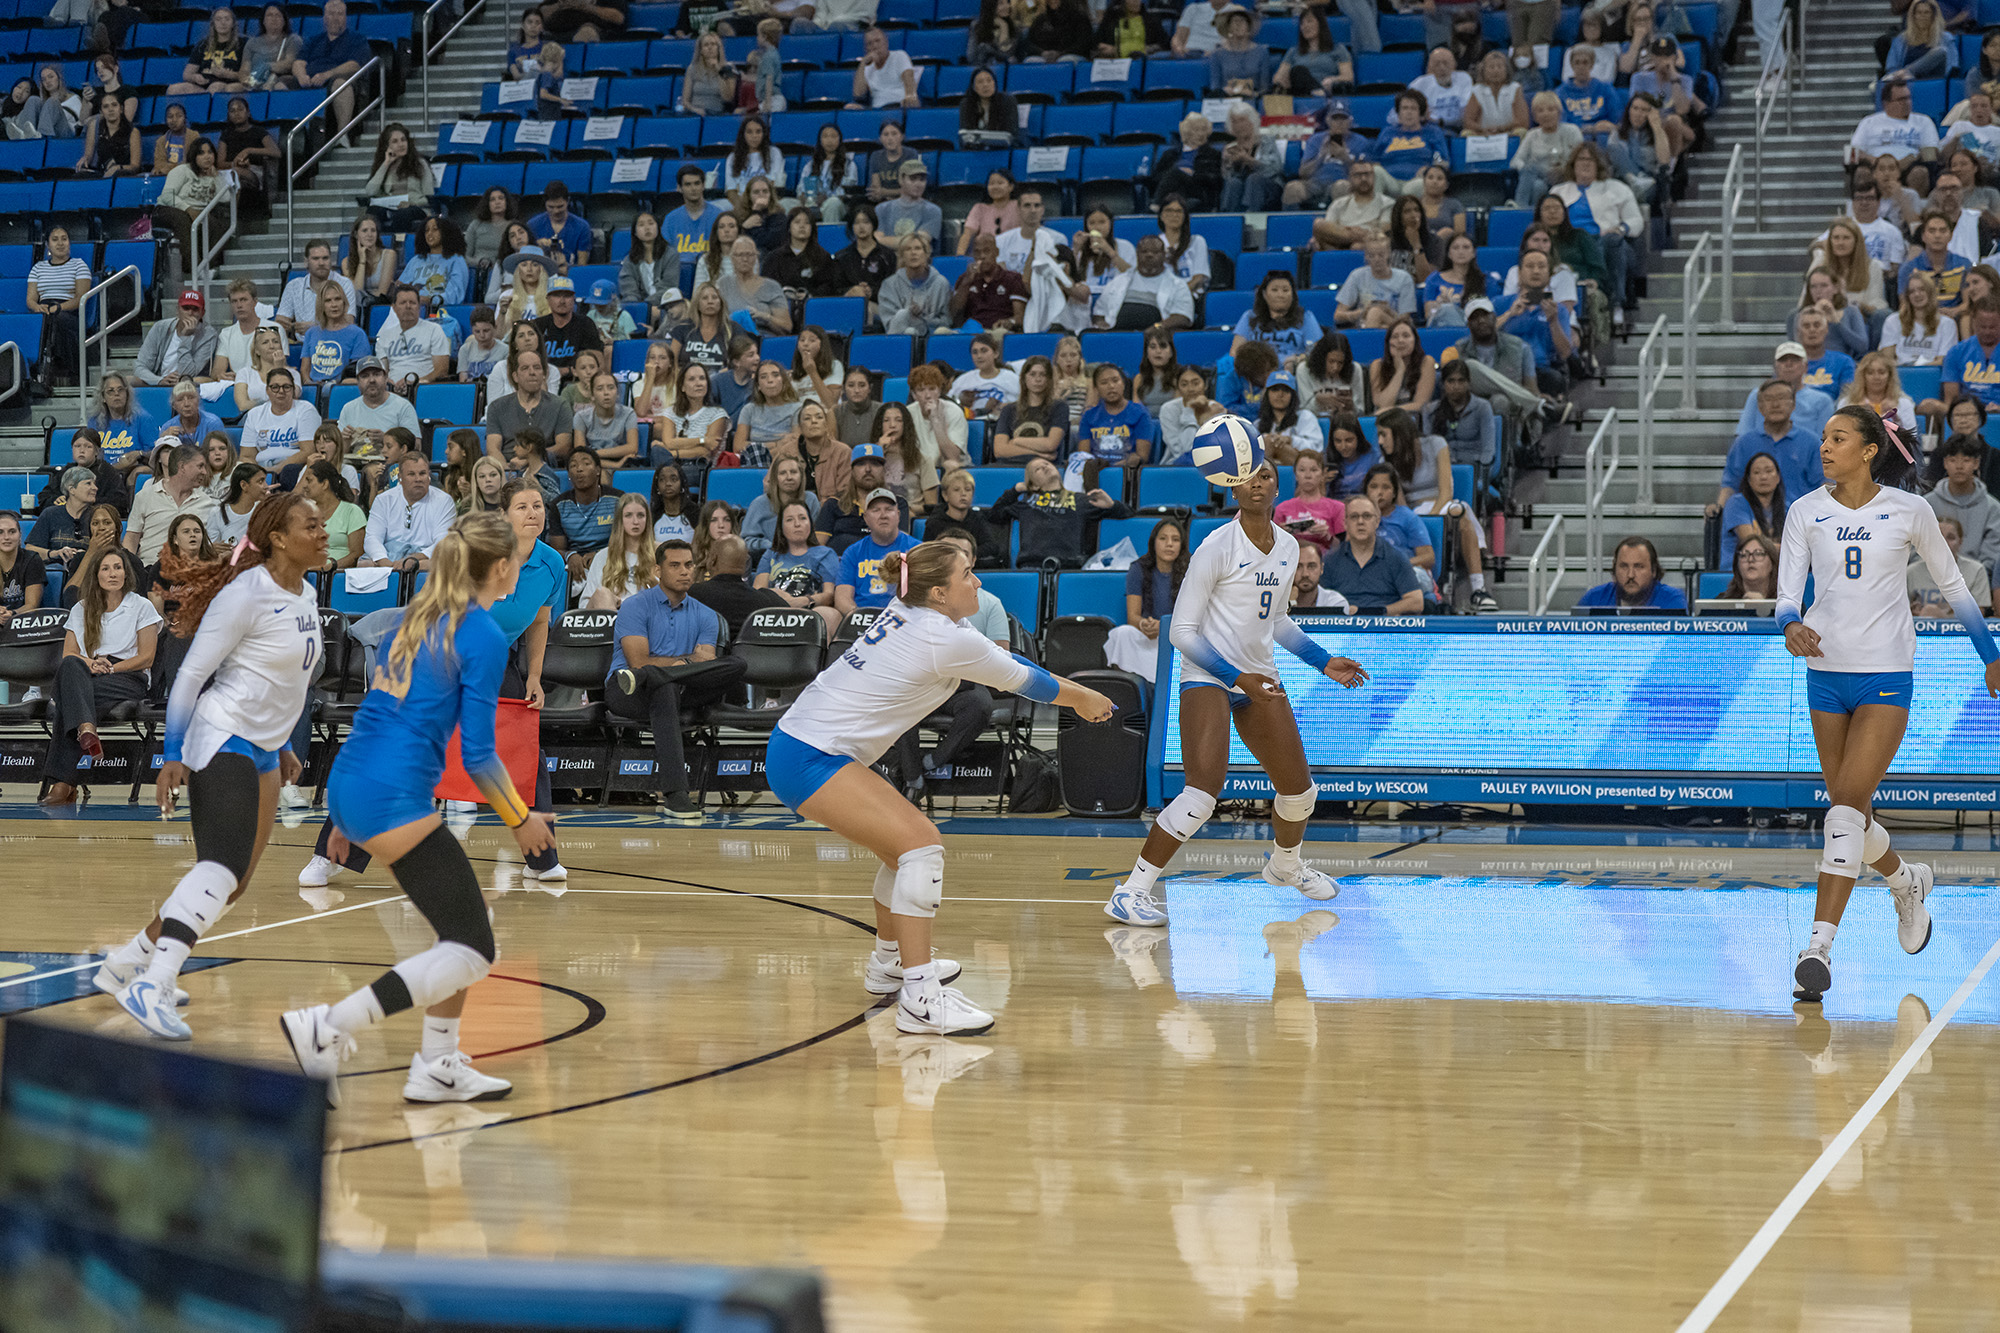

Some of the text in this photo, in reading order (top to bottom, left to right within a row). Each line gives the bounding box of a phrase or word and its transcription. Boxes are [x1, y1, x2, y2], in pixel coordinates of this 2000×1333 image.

[676, 233, 710, 253] Ucla
[185, 292, 199, 300] WIS
[388, 338, 423, 357] Ucla
[545, 340, 575, 358] Ucla
[686, 341, 723, 355] UCLA
[1801, 368, 1833, 385] cla
[98, 430, 134, 448] Ucla
[270, 427, 298, 442] Ucla
[660, 526, 683, 535] UCLA
[1836, 526, 1872, 541] Ucla
[1844, 545, 1862, 580] 8
[1254, 571, 1280, 587] Ucla
[1258, 590, 1273, 620] 9
[10, 613, 64, 630] READY
[295, 614, 317, 633] Ucla
[562, 615, 618, 628] READY
[752, 614, 810, 627] READY
[1295, 617, 1426, 629] presented by WESCOM
[1497, 620, 1748, 633] PAULEY PAVILION presented by WESCOM
[302, 637, 315, 671] 0
[2, 756, 35, 766] Health
[93, 756, 128, 767] Health
[560, 759, 595, 770] Health
[624, 763, 649, 772] UCLA
[722, 763, 747, 773] UCLA
[955, 766, 992, 778] Health
[1233, 780, 1277, 791] PAVILI
[1315, 781, 1354, 792] sented
[1358, 781, 1372, 795] by
[1375, 782, 1428, 794] WESCOM
[1481, 782, 1733, 800] PAULEY PAVILION presented by WESCOM
[1872, 790, 1996, 804] AVILION presented
